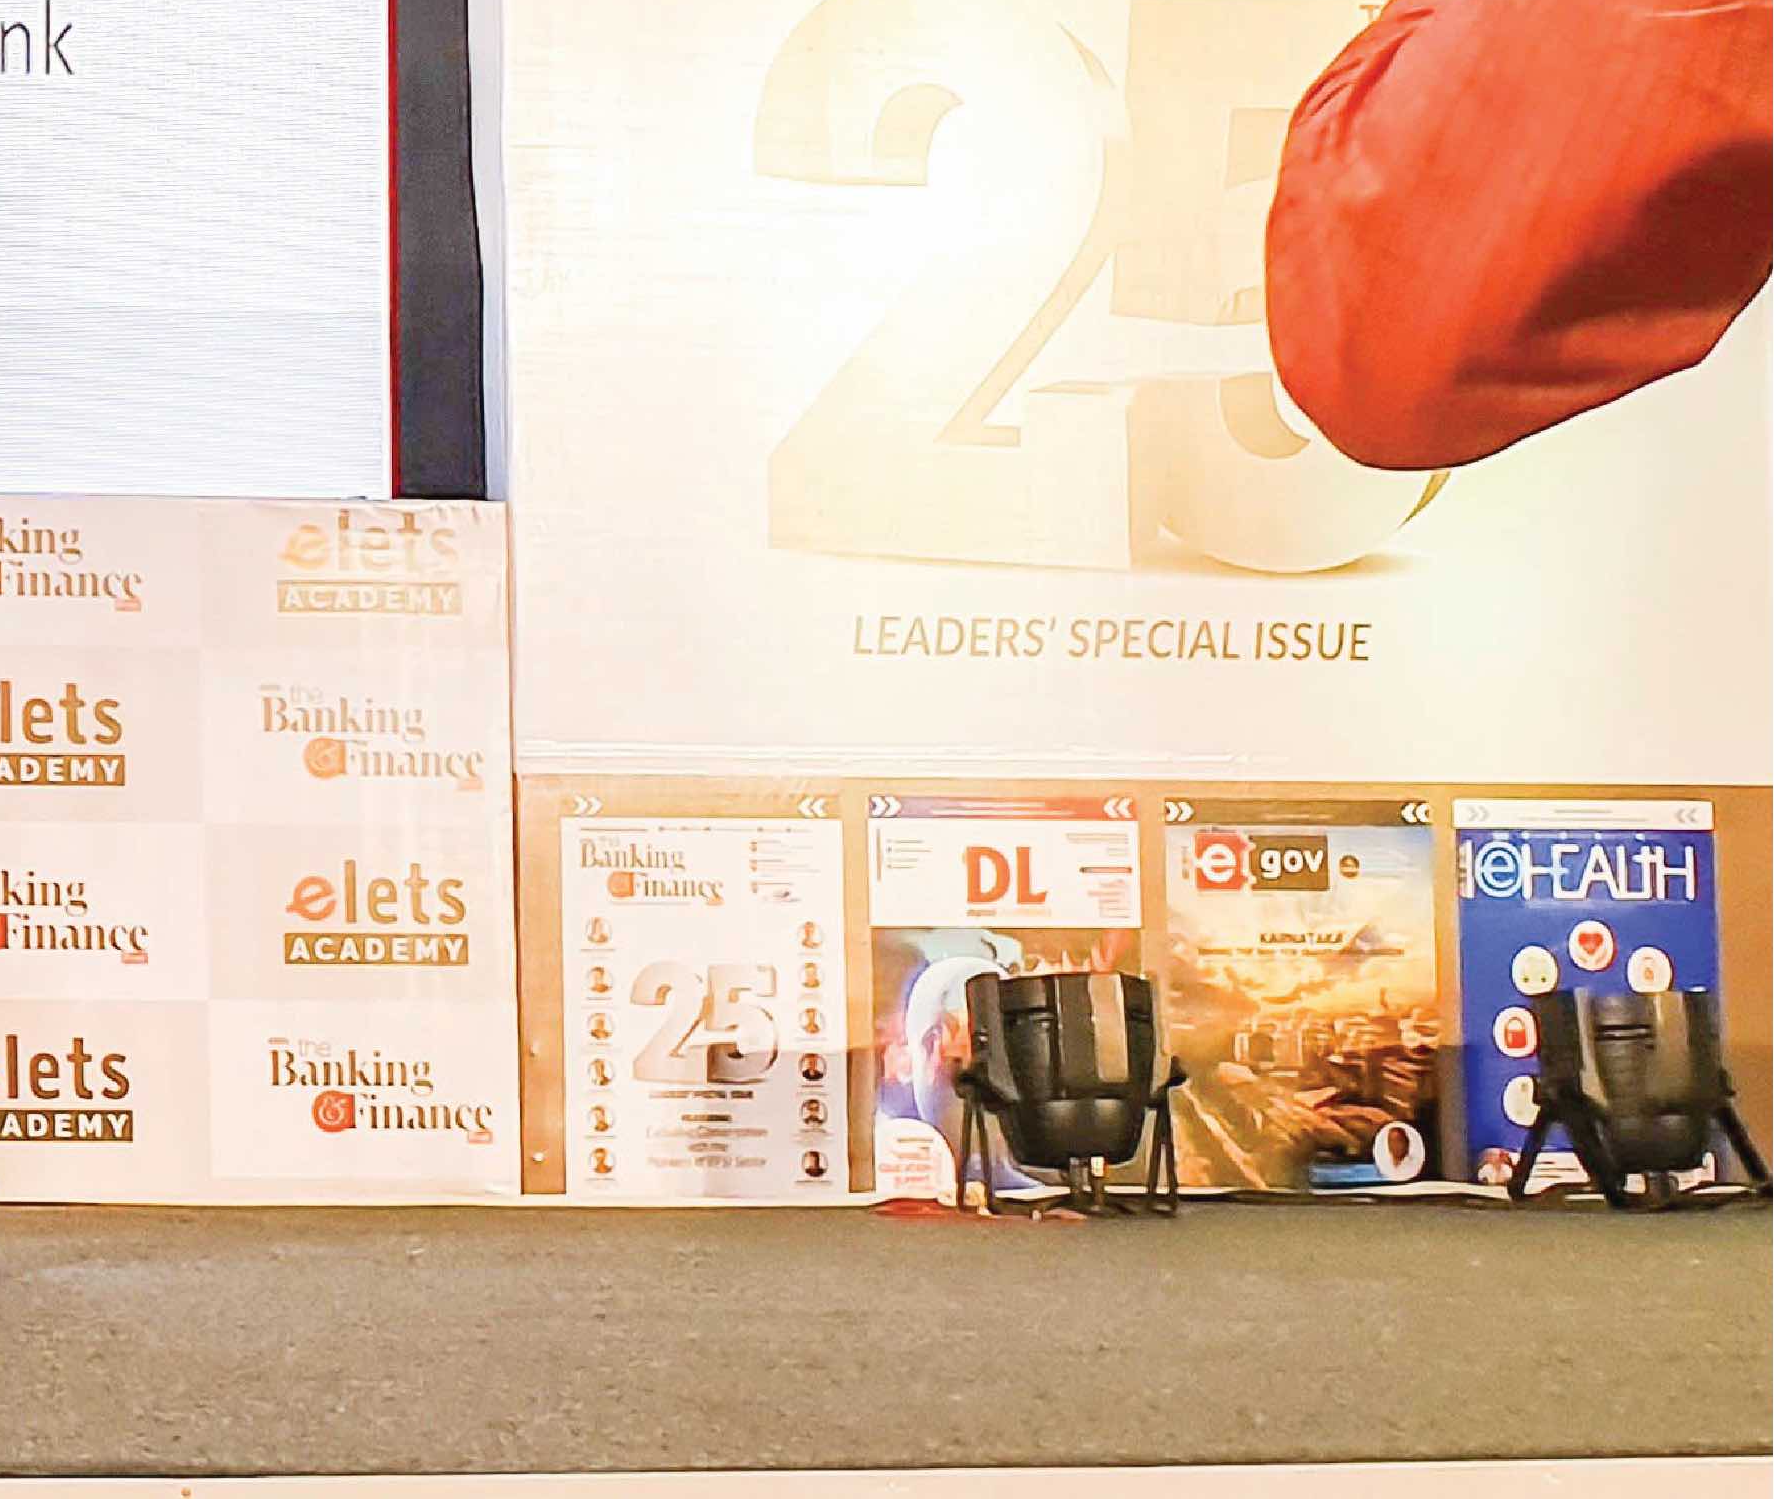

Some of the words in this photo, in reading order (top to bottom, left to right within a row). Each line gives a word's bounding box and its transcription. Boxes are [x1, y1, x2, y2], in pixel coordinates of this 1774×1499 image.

[279, 509, 459, 572] elets
[284, 589, 453, 609] ACADEMY
[1068, 619, 1240, 662] SPECIAL
[1254, 621, 1373, 663] ISSUE
[261, 697, 425, 744] Banking
[285, 860, 466, 925] elets
[964, 846, 1048, 905] DL
[290, 937, 463, 961] ACADEMY
[630, 961, 779, 1084] 25
[269, 1049, 433, 1096] Banking
